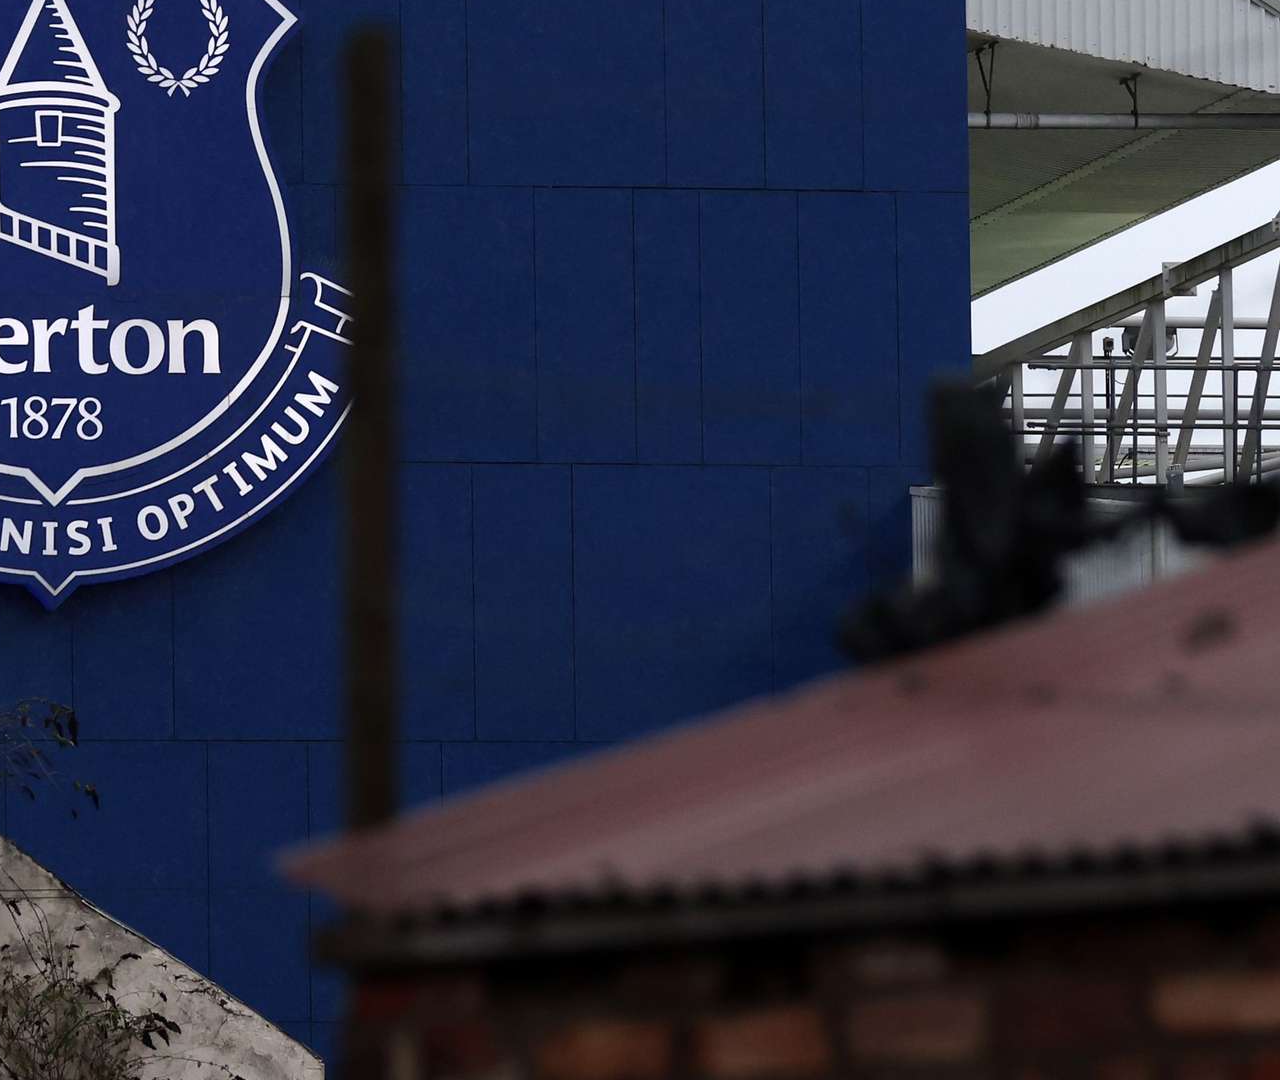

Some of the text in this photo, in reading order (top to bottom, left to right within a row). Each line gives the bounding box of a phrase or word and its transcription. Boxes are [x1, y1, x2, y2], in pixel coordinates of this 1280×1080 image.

[0, 395, 104, 441] 1878
[0, 517, 118, 556] NISI
[137, 370, 340, 541] OPTIMUM
